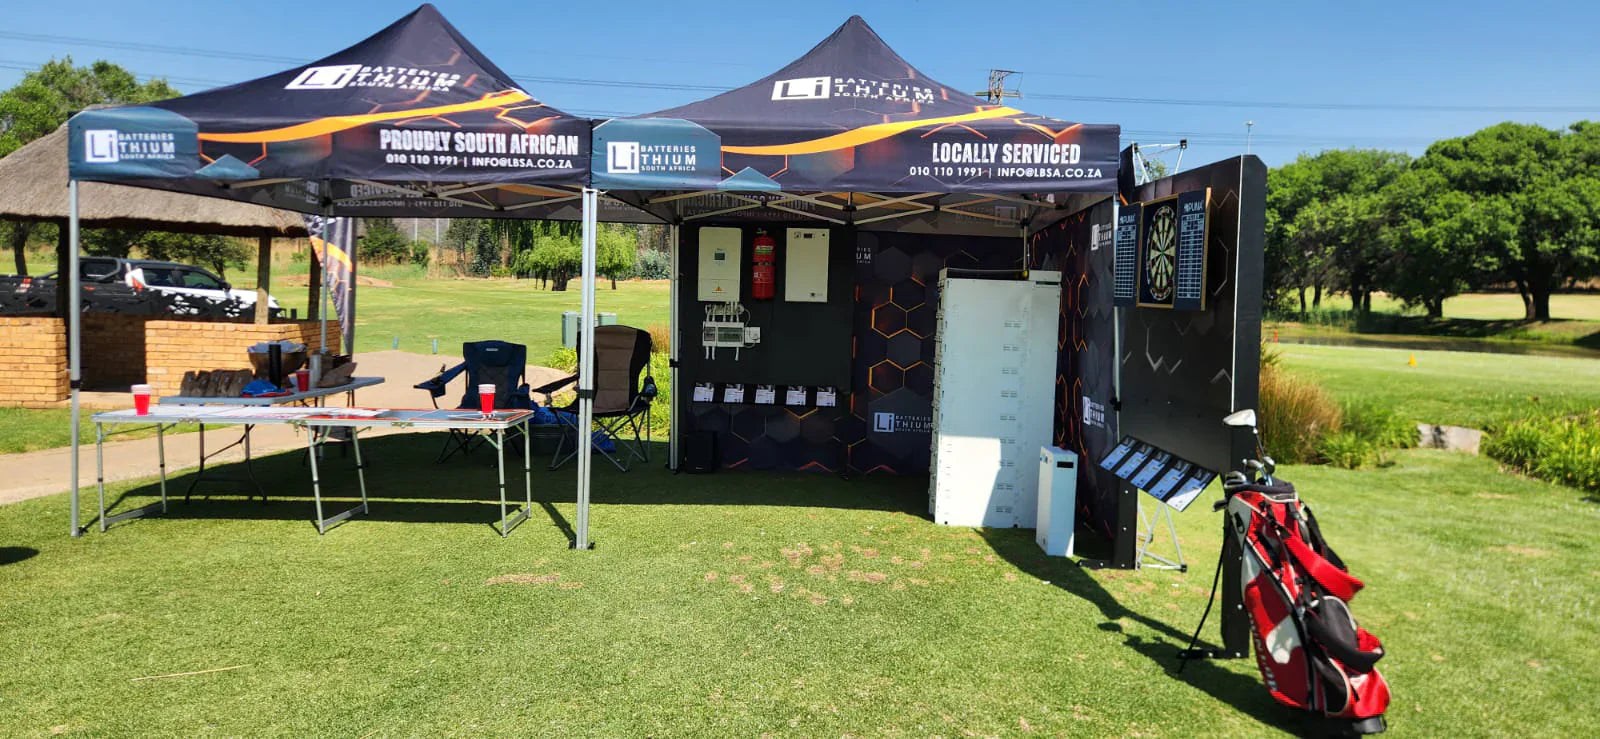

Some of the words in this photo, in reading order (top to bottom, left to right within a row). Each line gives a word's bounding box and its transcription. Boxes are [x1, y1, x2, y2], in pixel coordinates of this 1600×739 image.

[294, 66, 352, 87] Li
[356, 73, 458, 88] THIUM
[359, 66, 461, 80] BATTERIES
[398, 84, 450, 92] AFRICA
[777, 78, 827, 99] Li
[834, 78, 932, 94] BATTERIES
[835, 84, 934, 100] THIUM
[885, 96, 935, 104] AFRICA
[118, 133, 174, 141] BATTERIES
[379, 128, 451, 151] PROUDLY
[454, 132, 506, 154] SOUTH
[509, 134, 579, 156] AFRICAN
[90, 132, 114, 160] Li
[118, 141, 175, 153] THIUM
[640, 145, 696, 153] BATTERIES
[932, 142, 999, 164] LOCALLY
[1002, 143, 1081, 165] SERVICED
[385, 153, 407, 164] 010
[410, 154, 430, 165] 110
[433, 155, 458, 166] 1991
[472, 156, 573, 169] INFO@LBSA.CO.ZA
[611, 144, 637, 171] Li
[640, 154, 696, 165] THIUM
[909, 166, 930, 176] 010
[934, 166, 953, 176] 110
[957, 167, 982, 177] 1991
[997, 167, 1102, 178] INFO@LBSA.CO.ZA
[876, 413, 893, 431] Li
